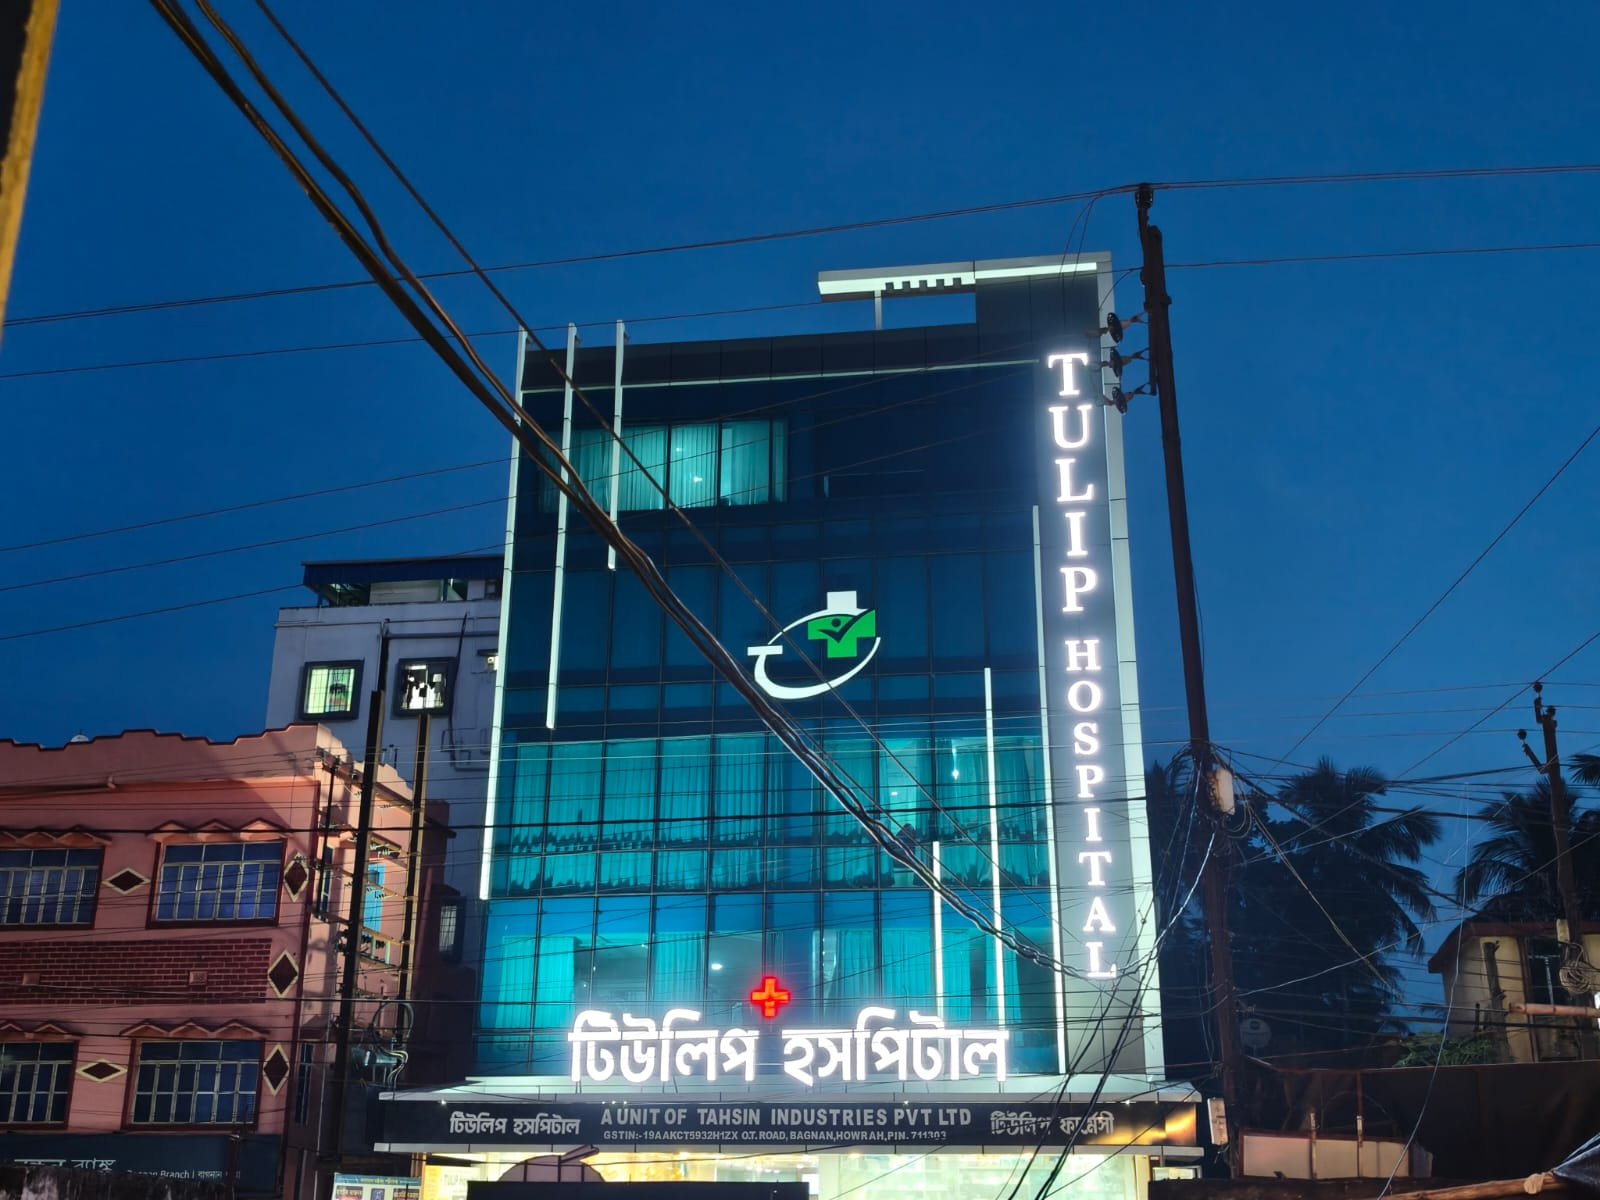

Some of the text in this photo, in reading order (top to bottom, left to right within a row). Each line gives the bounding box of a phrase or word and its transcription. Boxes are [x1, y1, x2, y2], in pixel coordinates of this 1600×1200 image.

[1045, 351, 1119, 980] TULIP HOSPITAL
[566, 1006, 1010, 1086] টিউলিপ হসপিটাল
[449, 1110, 581, 1136] টিউলিপ হসপিটাল
[600, 1108, 971, 1126] A UNIT OF TAHSIN INDUSTRIES PVT LTD
